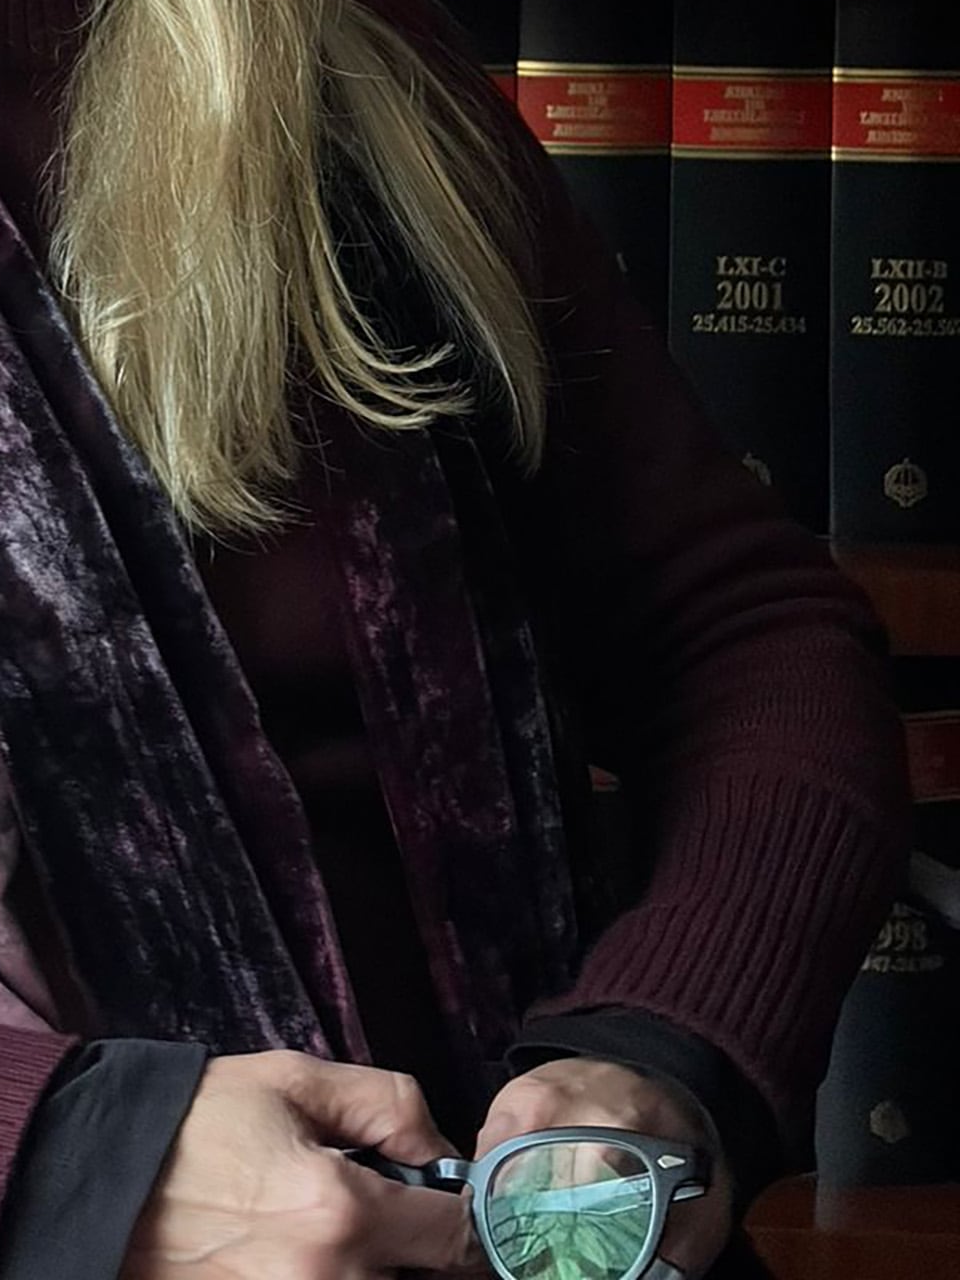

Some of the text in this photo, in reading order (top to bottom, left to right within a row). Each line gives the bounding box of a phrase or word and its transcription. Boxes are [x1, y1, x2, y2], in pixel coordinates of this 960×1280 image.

[716, 256, 787, 277] LXI-C
[716, 280, 783, 310] 2001
[874, 283, 945, 313] 2002
[872, 920, 928, 951] 998
